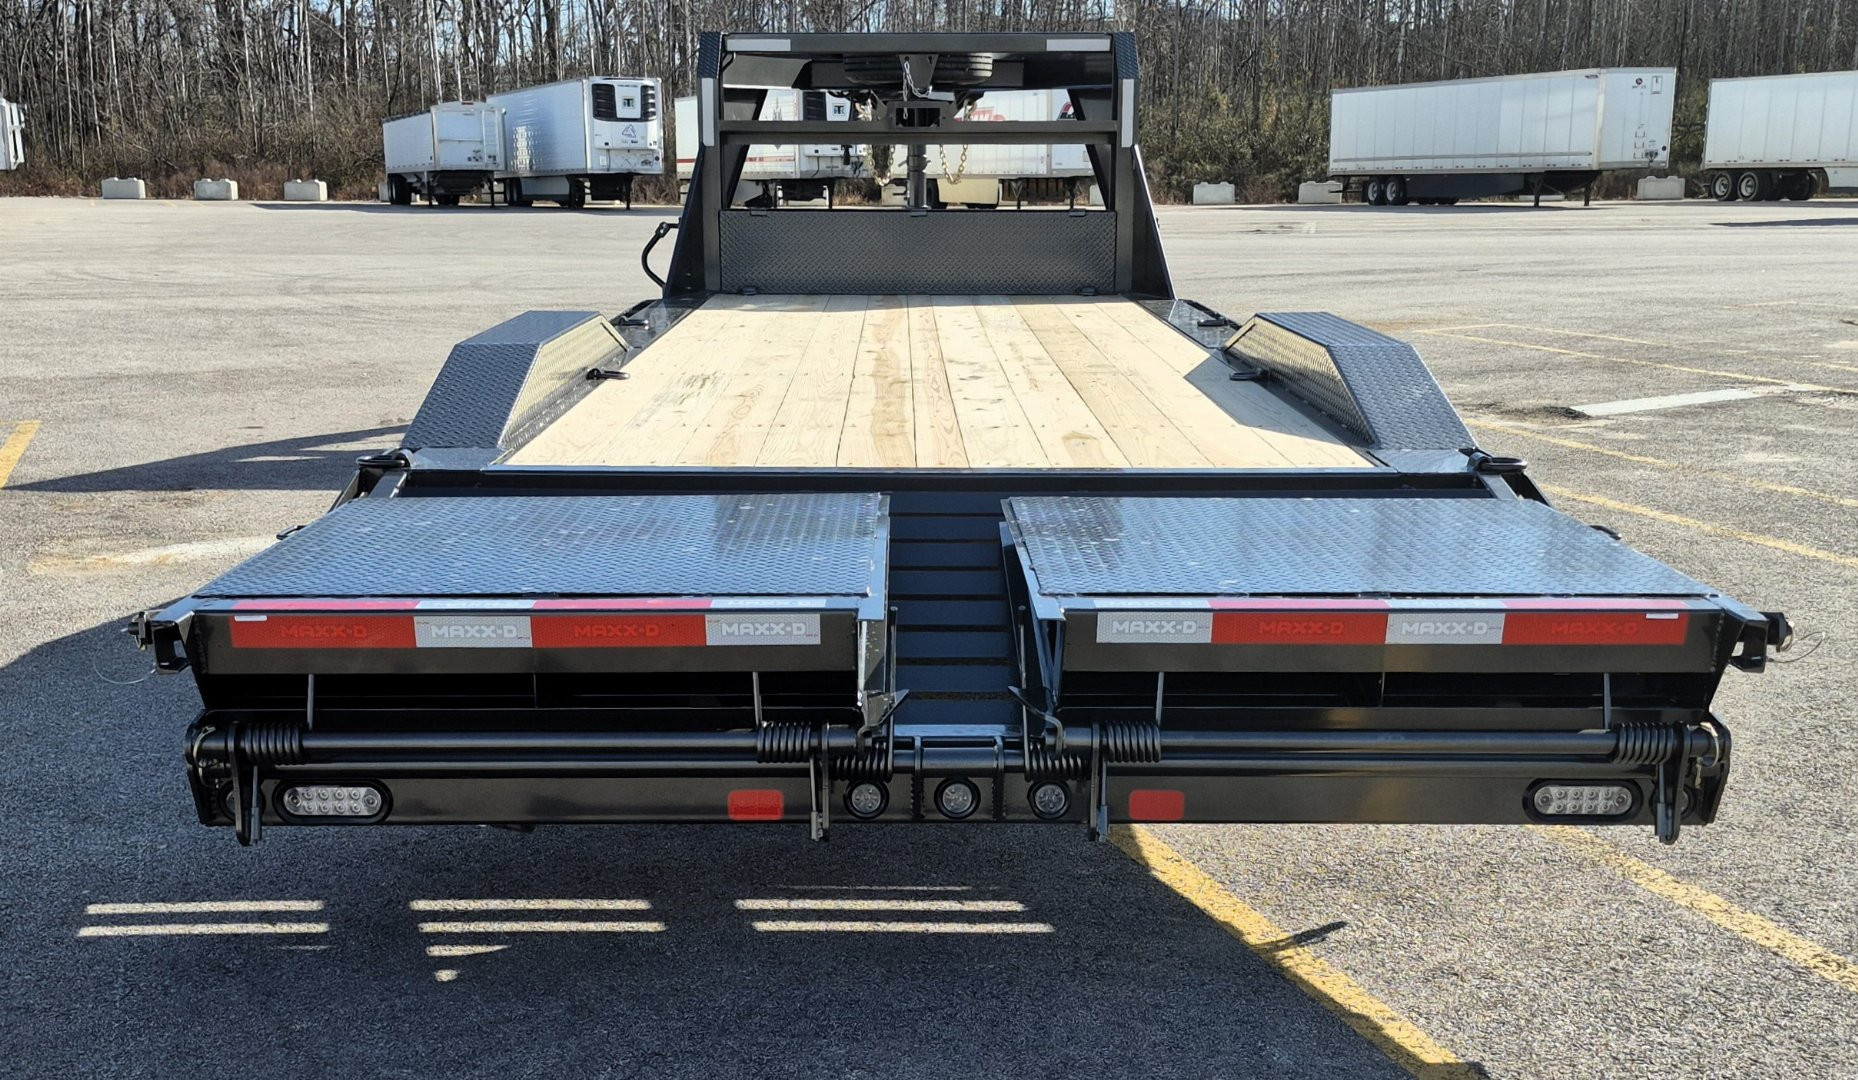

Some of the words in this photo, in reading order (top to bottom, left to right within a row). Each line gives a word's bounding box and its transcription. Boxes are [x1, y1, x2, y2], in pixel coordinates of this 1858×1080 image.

[280, 625, 367, 638] MAXX-D
[430, 625, 518, 638] MAXX-D
[574, 624, 659, 637] MAXX-D
[721, 622, 806, 636] MAXX-D
[1112, 621, 1197, 634] MAXX-D
[1260, 621, 1344, 634] MAXX-D
[1402, 622, 1487, 635] MAXX-D
